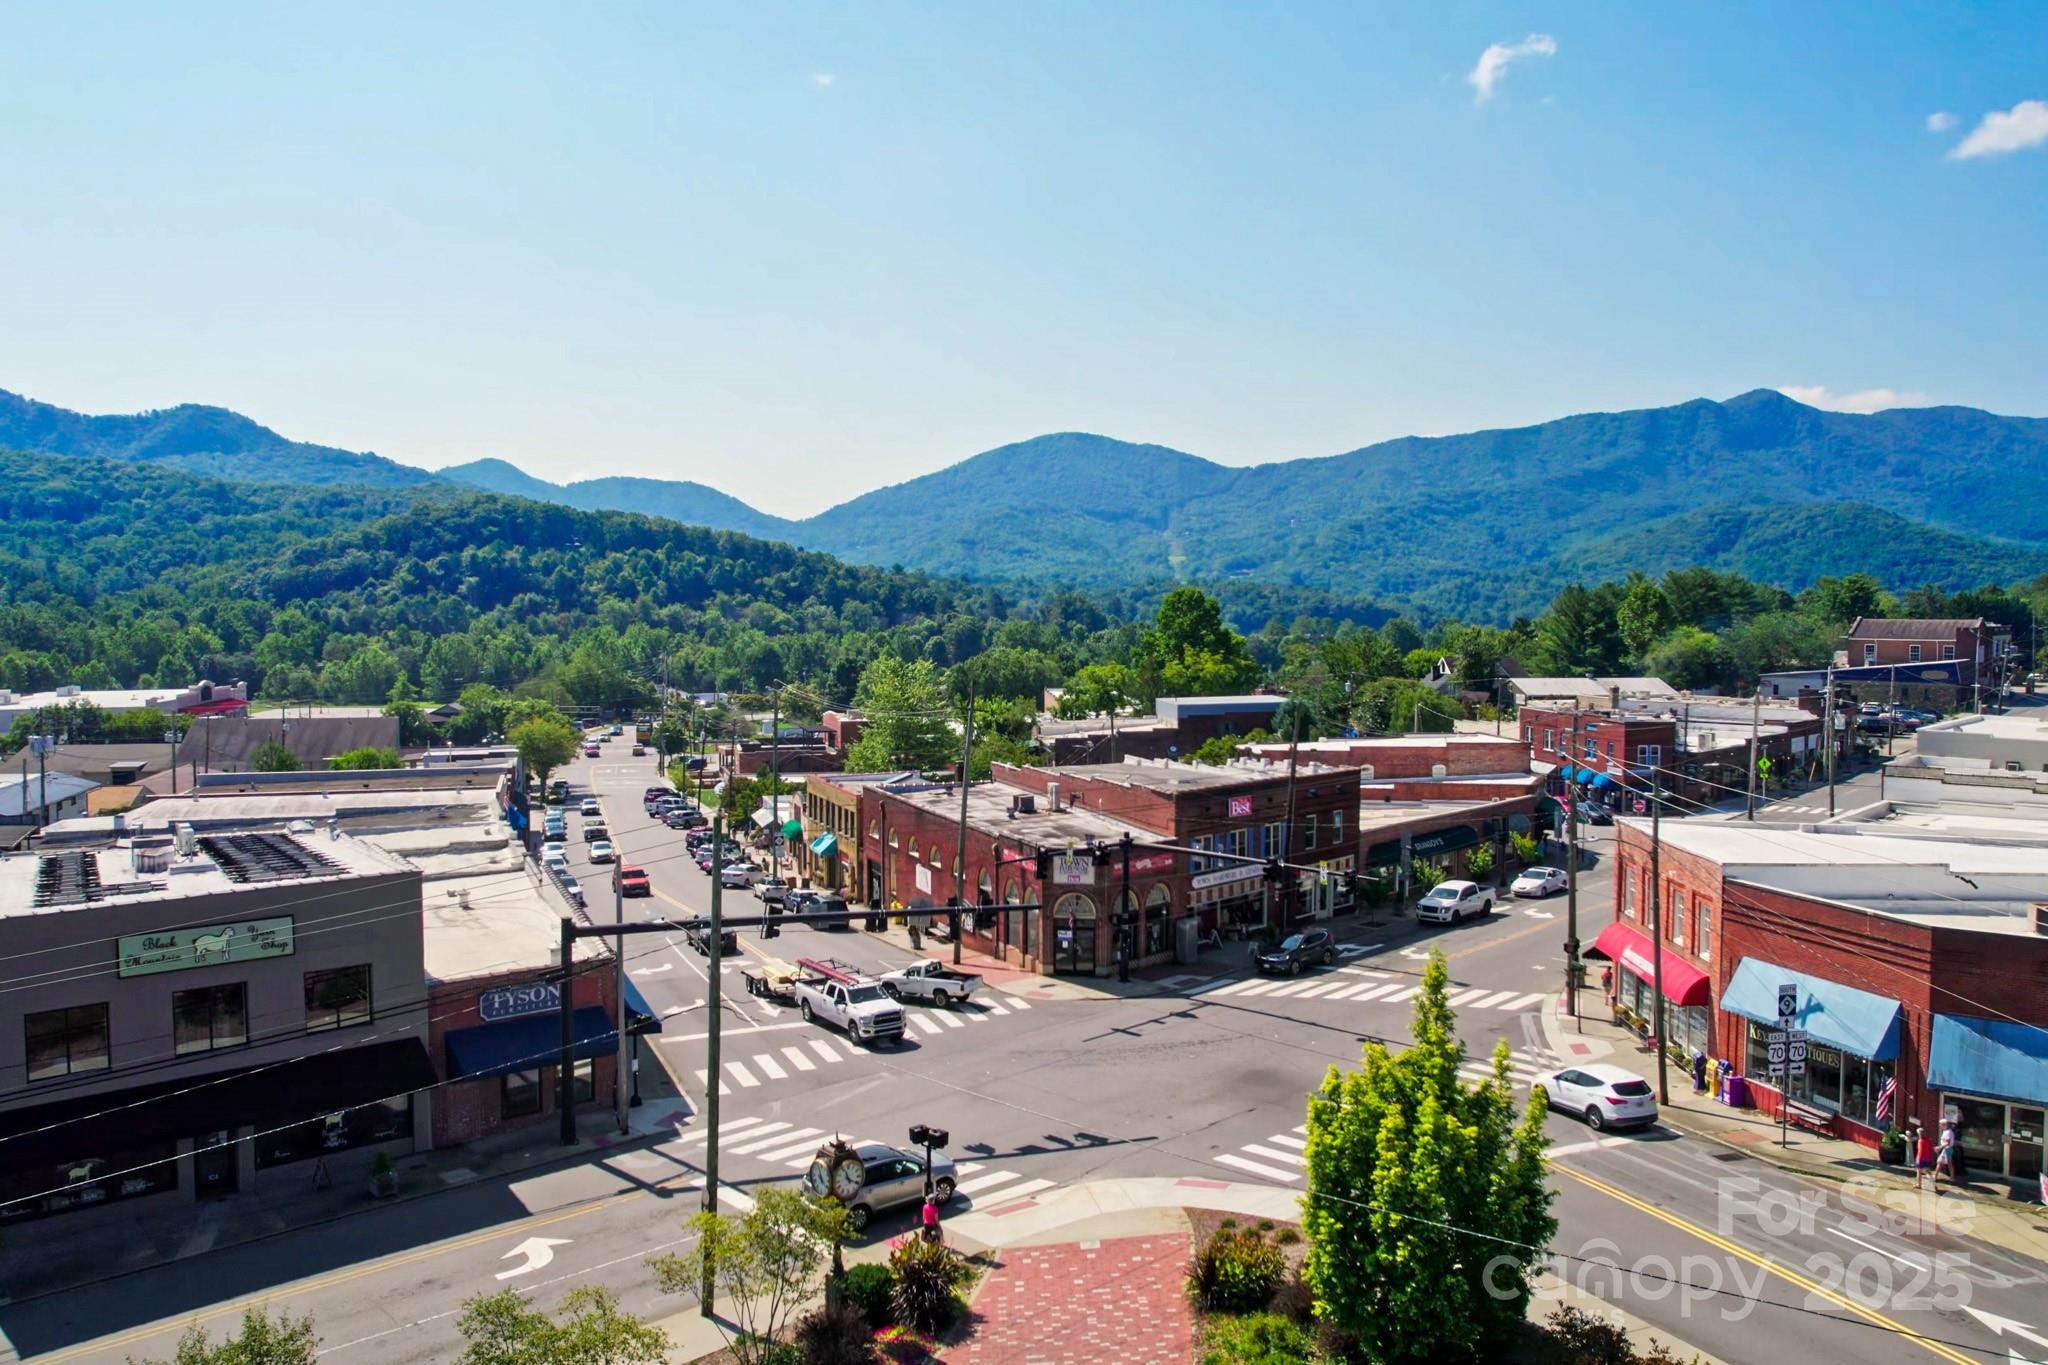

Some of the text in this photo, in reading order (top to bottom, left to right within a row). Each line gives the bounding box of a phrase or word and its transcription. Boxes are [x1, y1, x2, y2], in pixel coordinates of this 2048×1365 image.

[1231, 801, 1250, 815] Best
[142, 935, 178, 951] Black
[260, 939, 288, 952] Shop
[489, 983, 560, 1009] TYSON
[1783, 1000, 1790, 1011] 9
[1769, 1047, 1784, 1060] 70
[1791, 1045, 1804, 1058] 70
